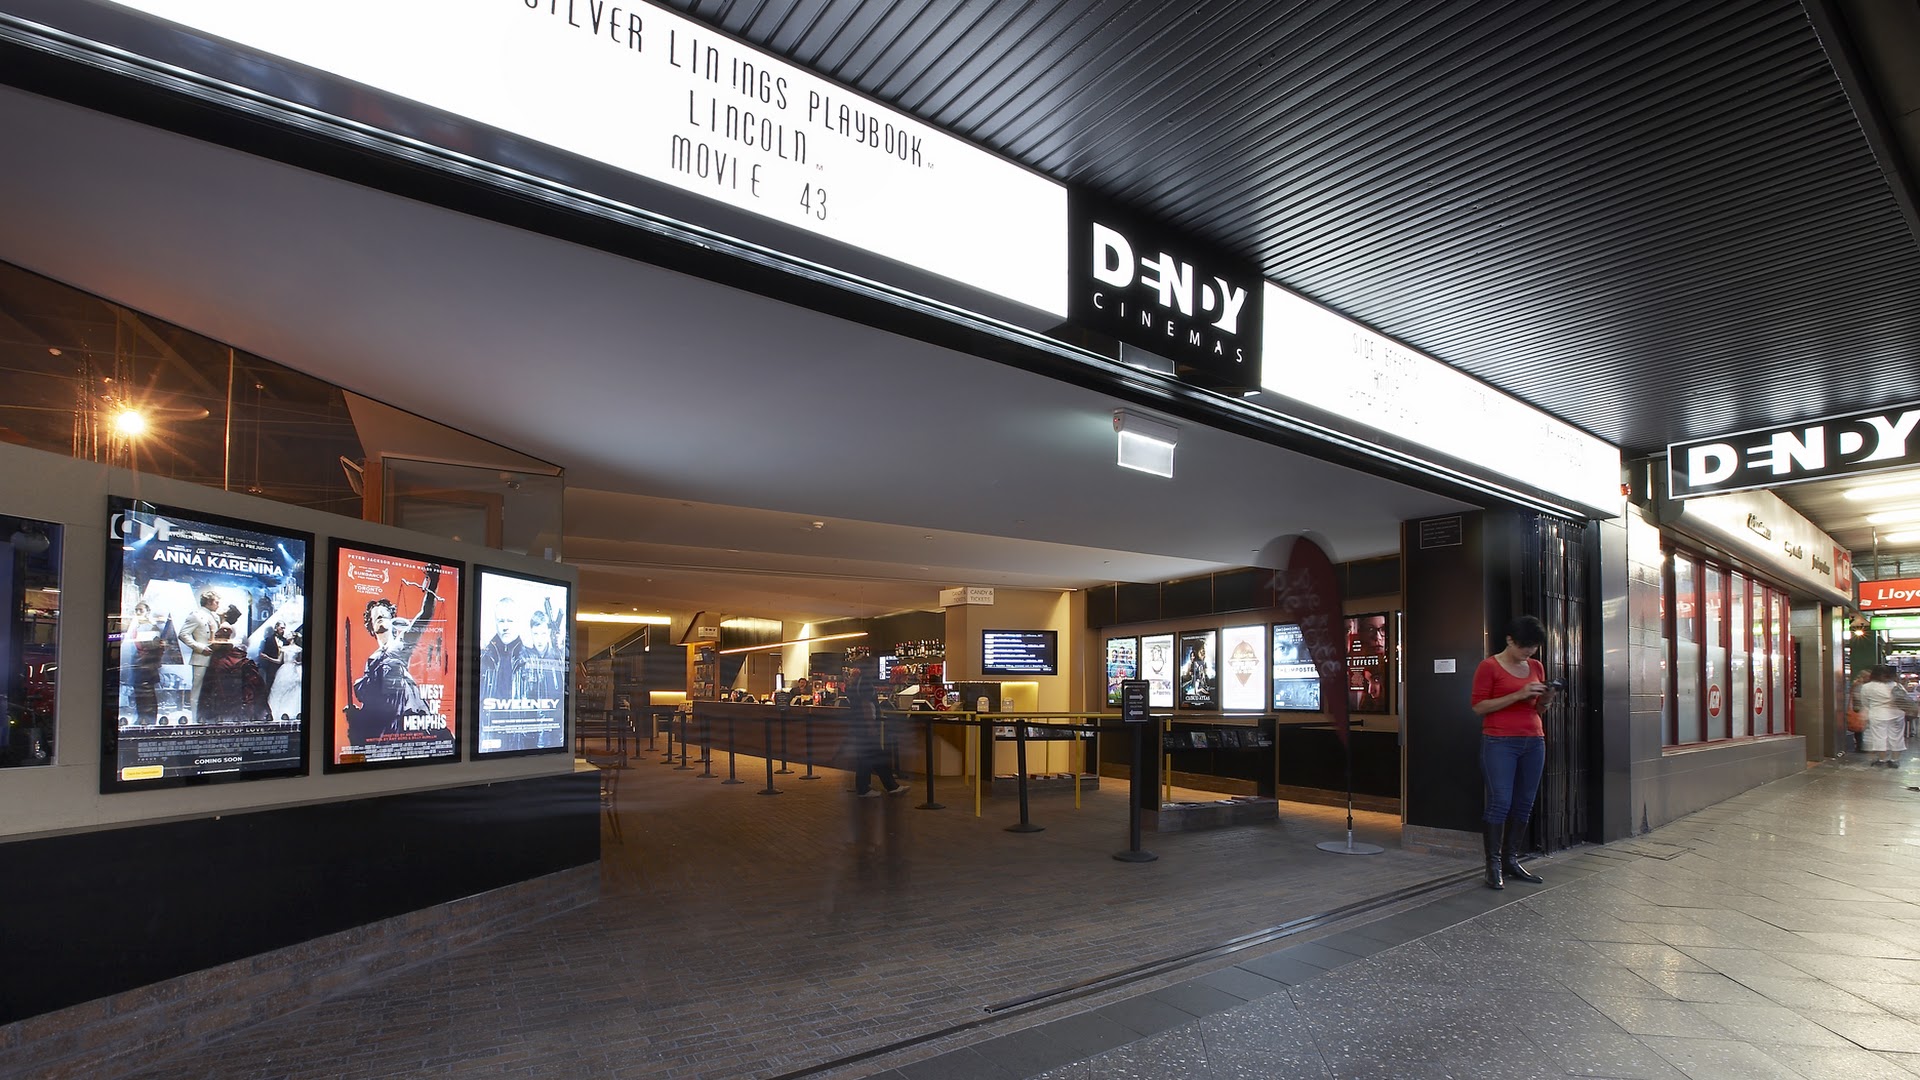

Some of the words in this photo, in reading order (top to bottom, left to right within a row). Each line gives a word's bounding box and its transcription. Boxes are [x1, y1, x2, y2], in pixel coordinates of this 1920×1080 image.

[524, 0, 643, 53] LVER
[808, 90, 922, 168] PLAYBOOK
[689, 89, 806, 165] LINCOLN
[671, 134, 762, 198] MOVIE
[799, 182, 827, 221] 43
[1092, 221, 1249, 335] DENDY
[1092, 292, 1243, 363] CINEMAS
[1687, 409, 1920, 488] DENDY
[153, 549, 204, 567] ANNA
[206, 555, 284, 577] KARENINA
[367, 556, 391, 565] JACKSON
[354, 570, 383, 579] SUNDANCE
[354, 584, 383, 593] TORONTO
[1353, 658, 1379, 666] EFFECTS
[419, 684, 445, 700] WEST
[430, 699, 442, 715] OF
[483, 698, 560, 710] SWEENEY
[403, 713, 447, 731] MEMPHIS
[194, 757, 222, 765] COMING
